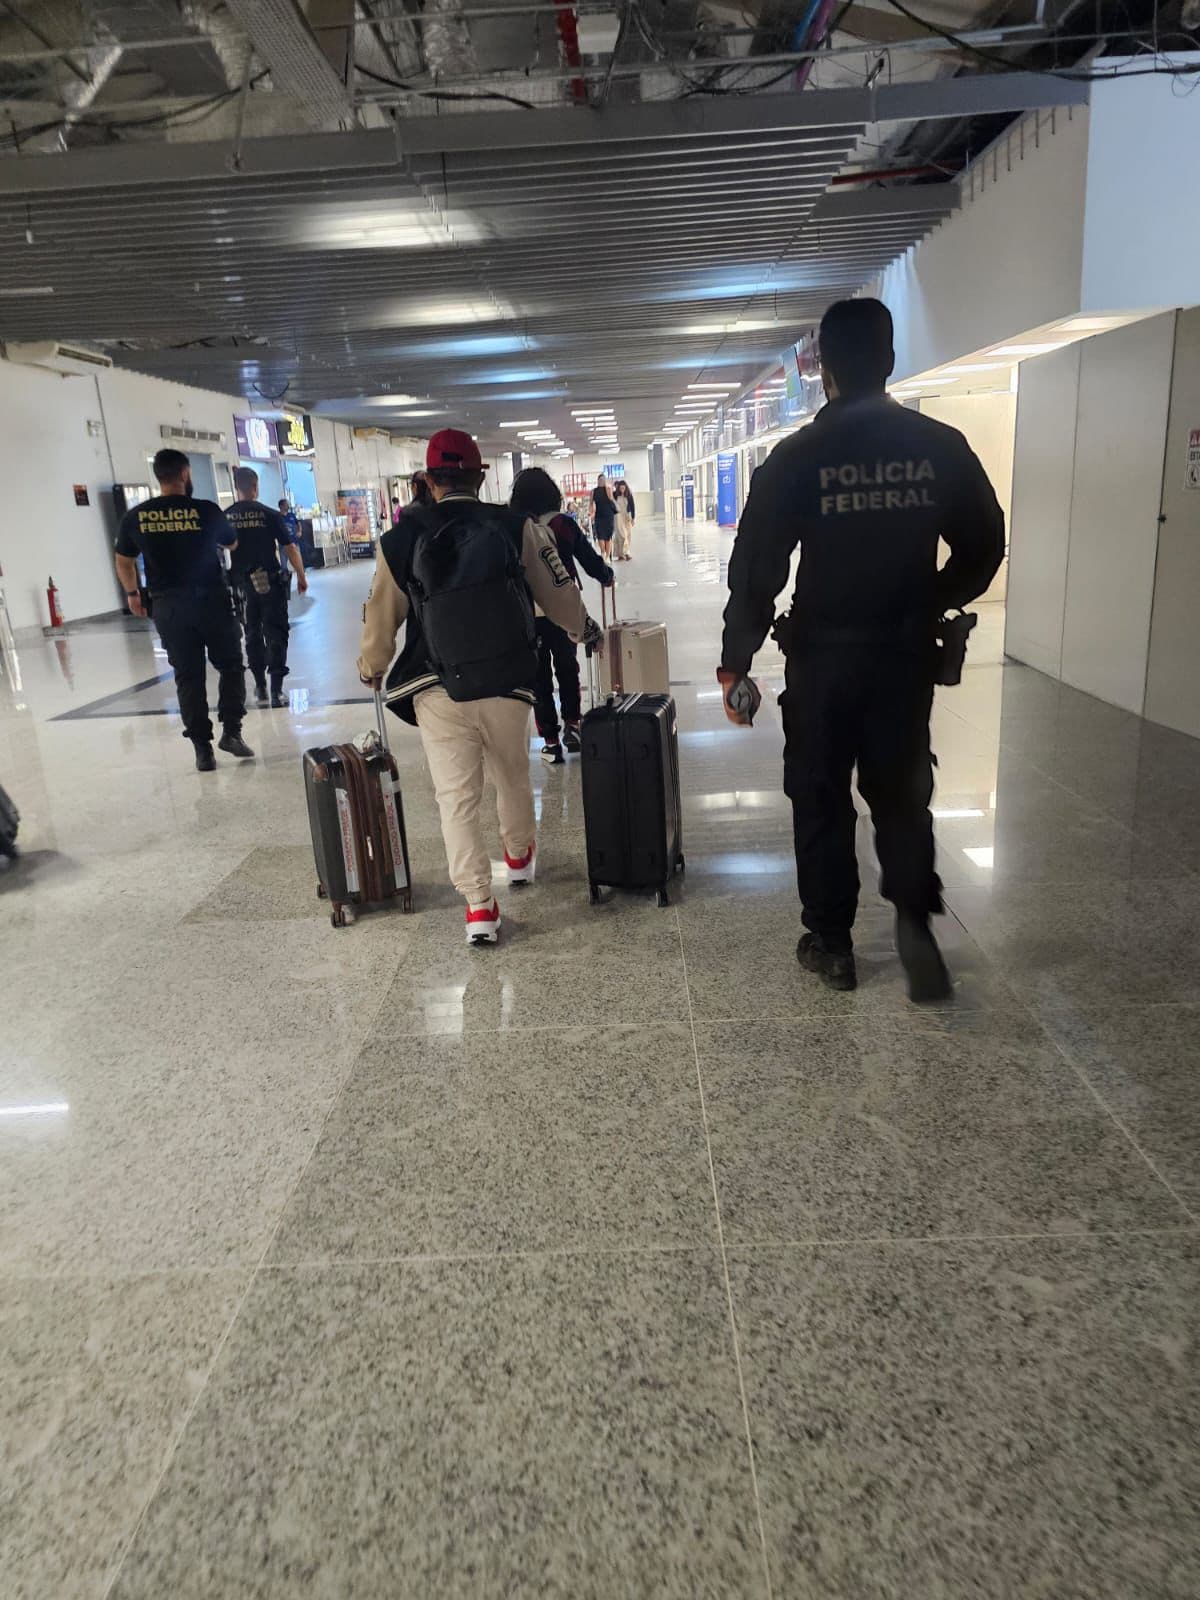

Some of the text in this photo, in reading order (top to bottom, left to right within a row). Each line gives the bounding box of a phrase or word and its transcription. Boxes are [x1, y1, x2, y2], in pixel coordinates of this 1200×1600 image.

[819, 458, 936, 488] POLÍCIA
[820, 488, 936, 515] FEDERAL
[138, 508, 200, 521] POLÍCIA
[139, 520, 201, 533] FEDERAL
[231, 520, 266, 529] EDERAL
